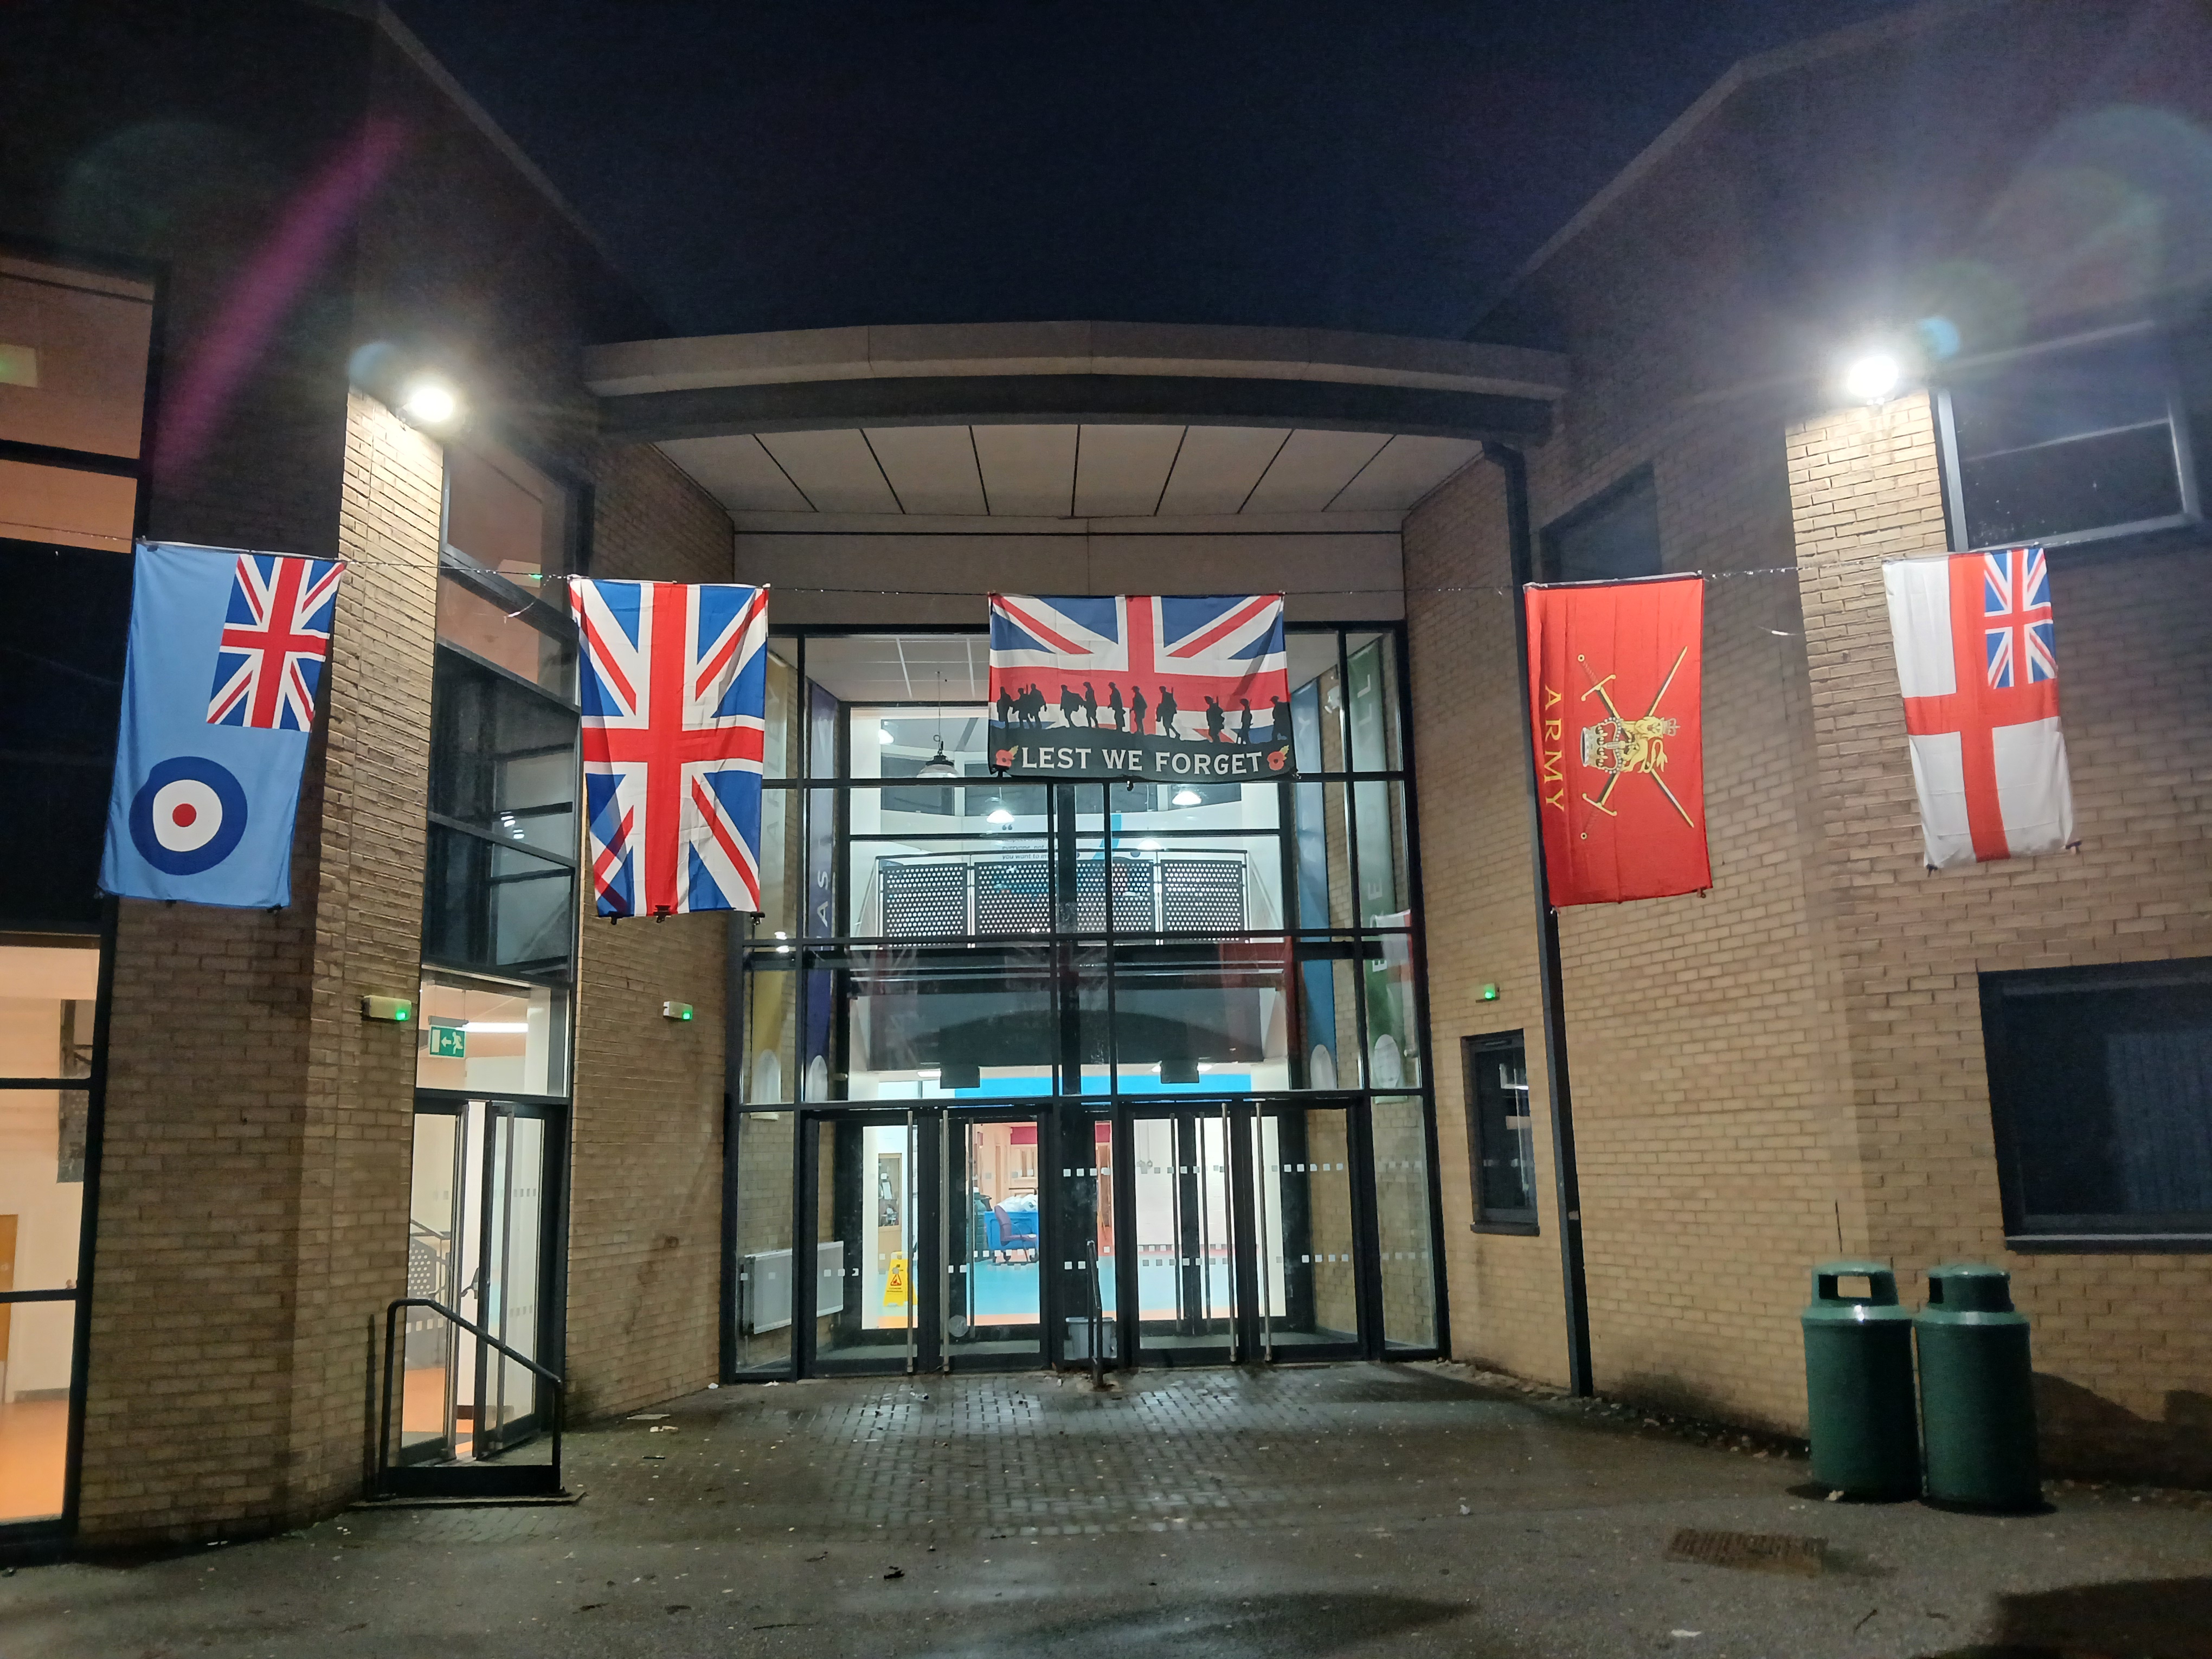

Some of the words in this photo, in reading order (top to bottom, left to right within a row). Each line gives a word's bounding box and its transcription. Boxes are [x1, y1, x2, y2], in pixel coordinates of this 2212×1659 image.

[1021, 747, 1091, 769] LEST
[1102, 749, 1142, 771] WE
[1155, 751, 1262, 775] FORGET
[1544, 685, 1565, 812] ARMY
